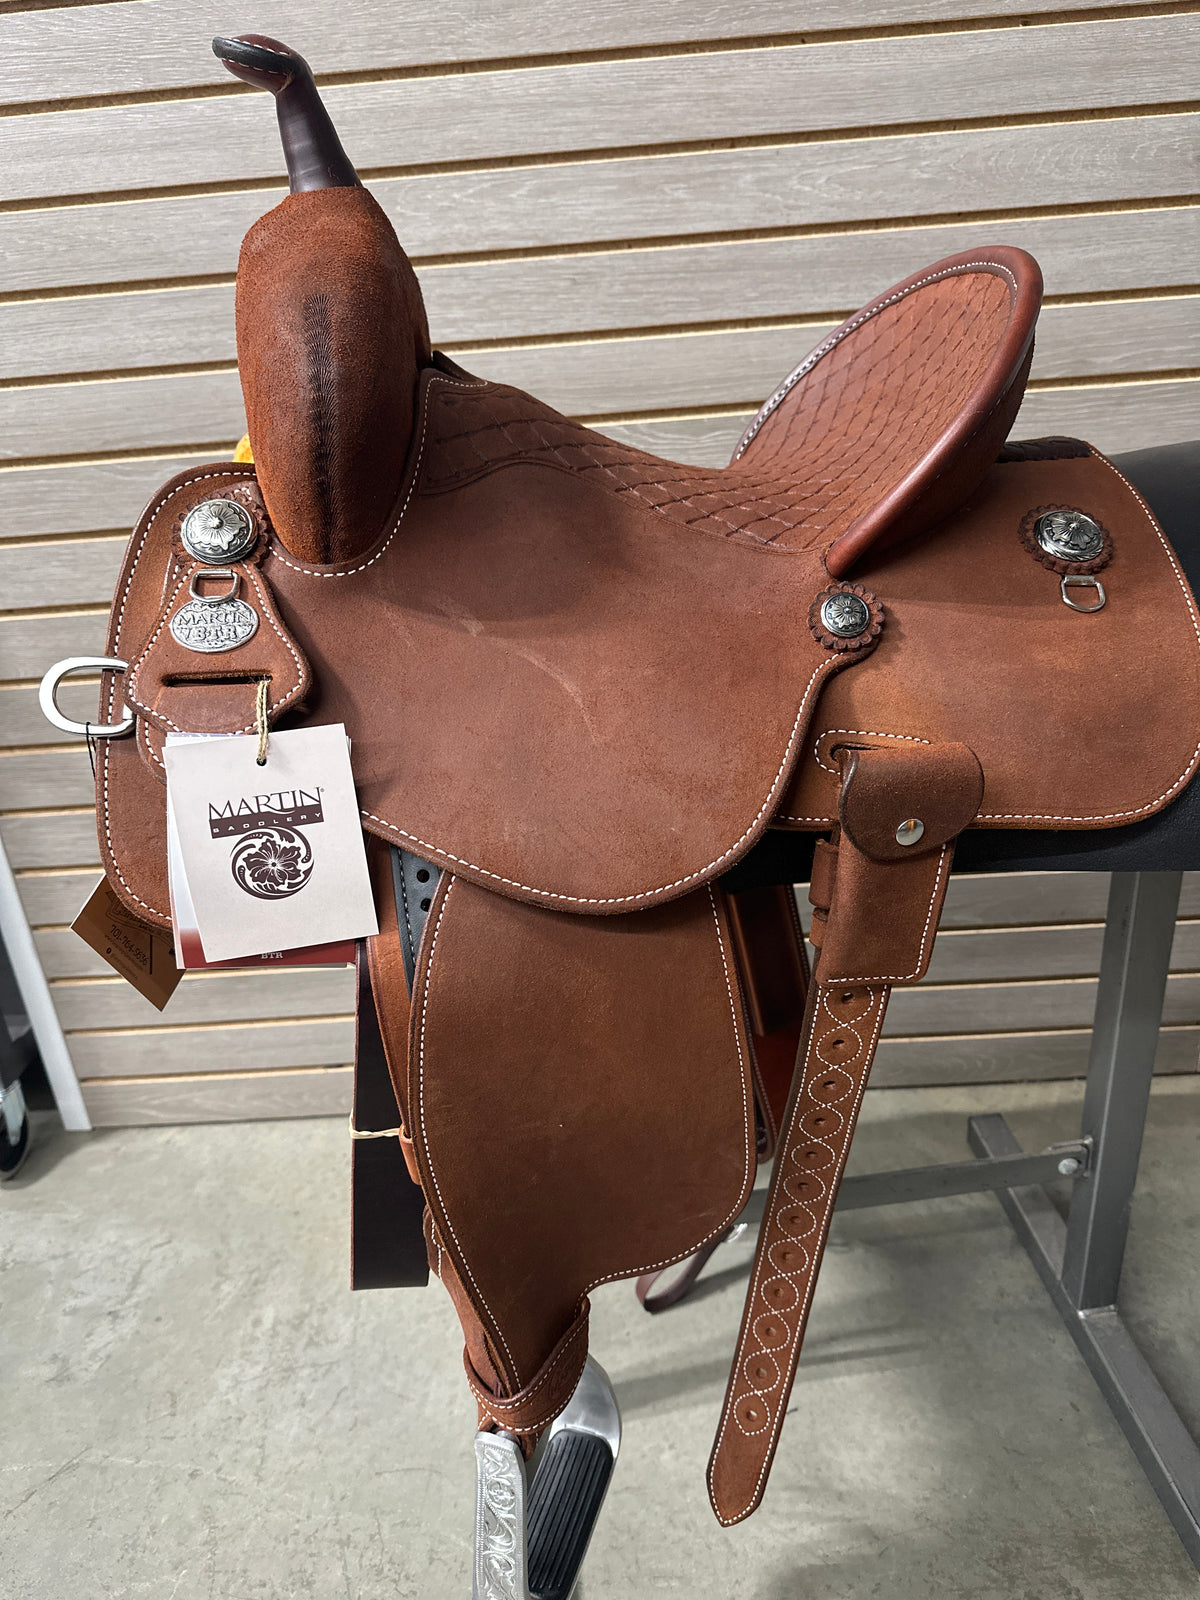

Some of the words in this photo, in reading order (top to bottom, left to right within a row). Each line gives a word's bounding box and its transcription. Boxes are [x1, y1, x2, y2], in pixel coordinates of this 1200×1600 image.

[178, 610, 252, 626] MARTIN
[213, 811, 322, 834] SADDLERY
[261, 951, 283, 959] BTR
